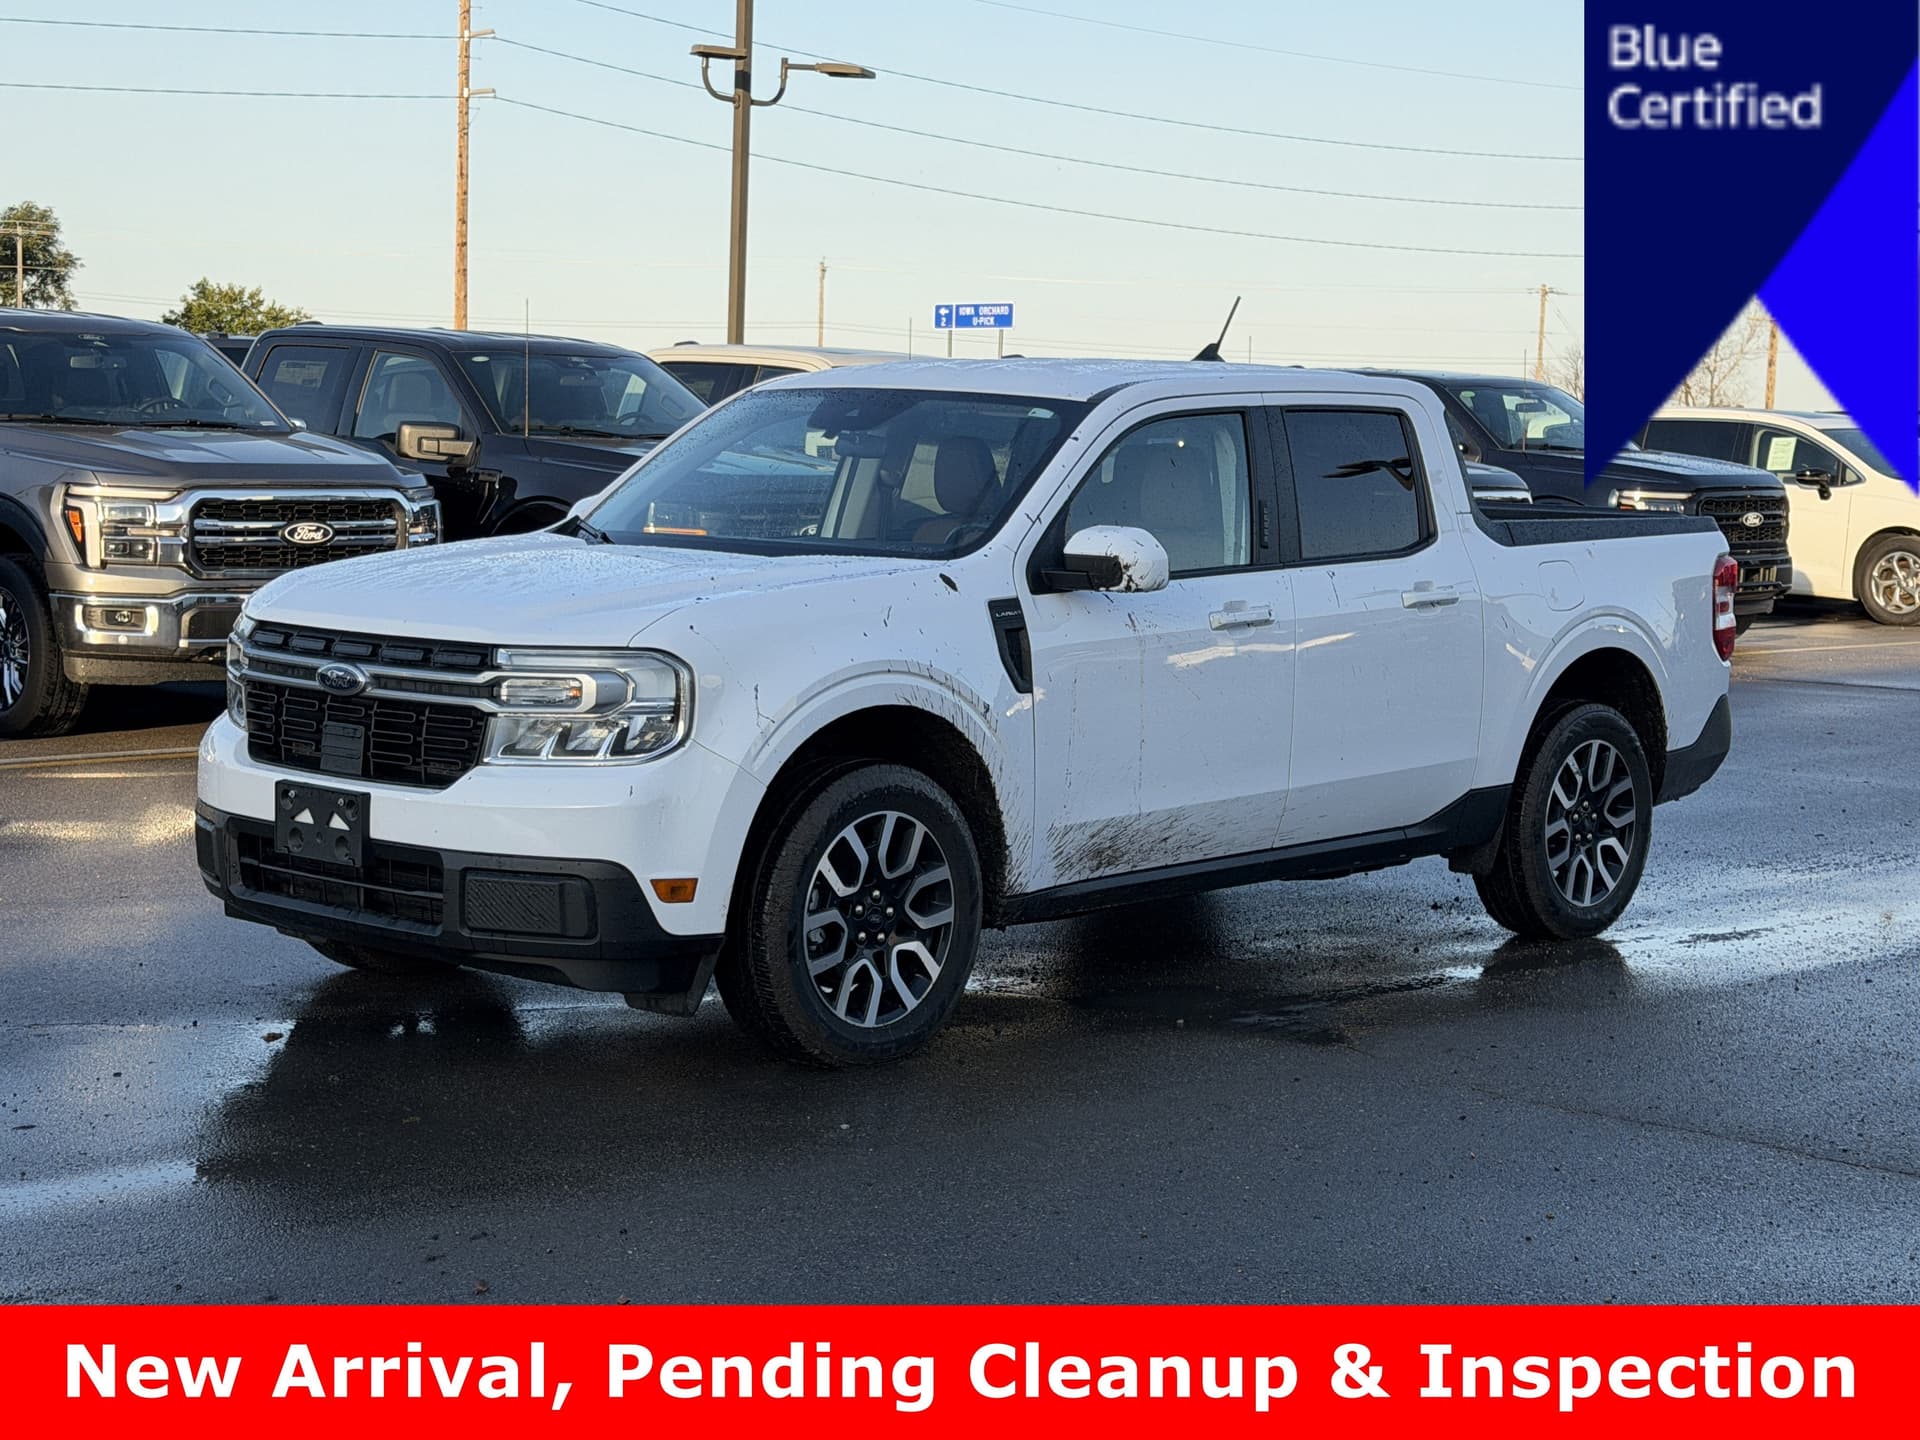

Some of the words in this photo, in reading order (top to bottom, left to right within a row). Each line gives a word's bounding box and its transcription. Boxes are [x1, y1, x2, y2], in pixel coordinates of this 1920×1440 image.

[959, 306, 975, 316] IOWA
[979, 305, 1009, 315] ORCHARD
[940, 317, 946, 327] 2
[294, 526, 324, 540] Ford
